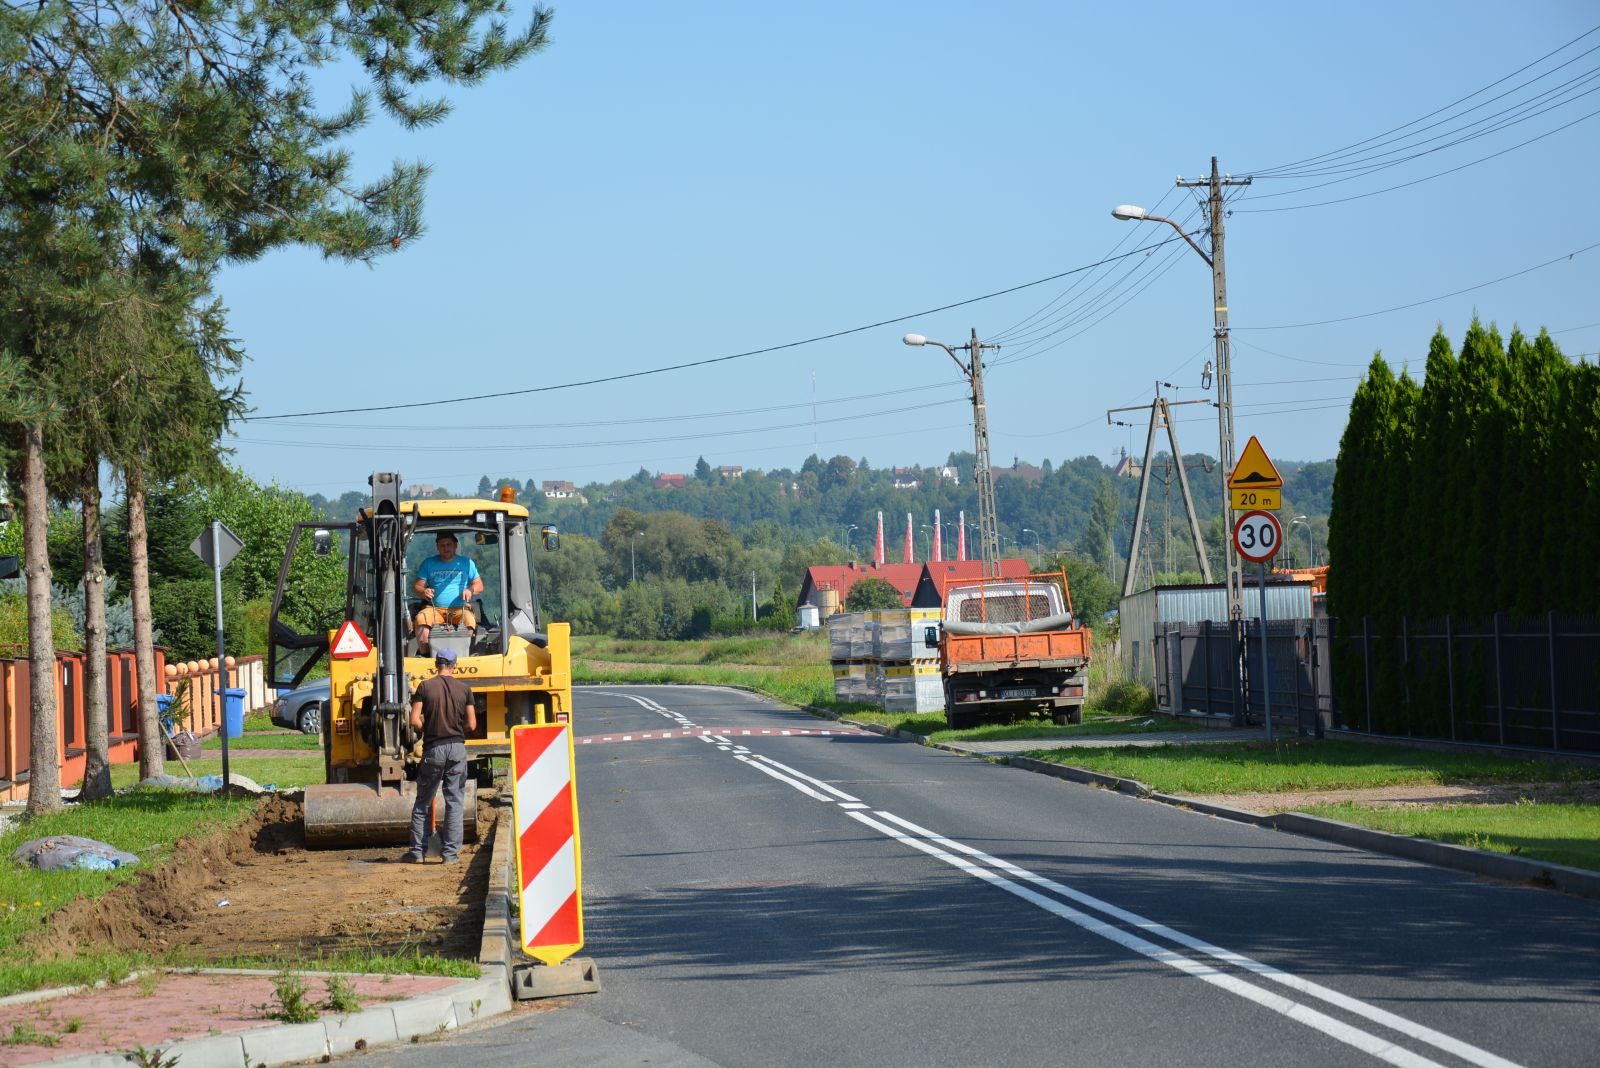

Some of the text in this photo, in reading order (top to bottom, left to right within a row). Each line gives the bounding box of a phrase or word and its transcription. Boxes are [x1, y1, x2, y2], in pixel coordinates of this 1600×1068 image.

[1241, 493, 1257, 505] 20
[1241, 524, 1274, 548] 30
[427, 666, 478, 675] VLVO
